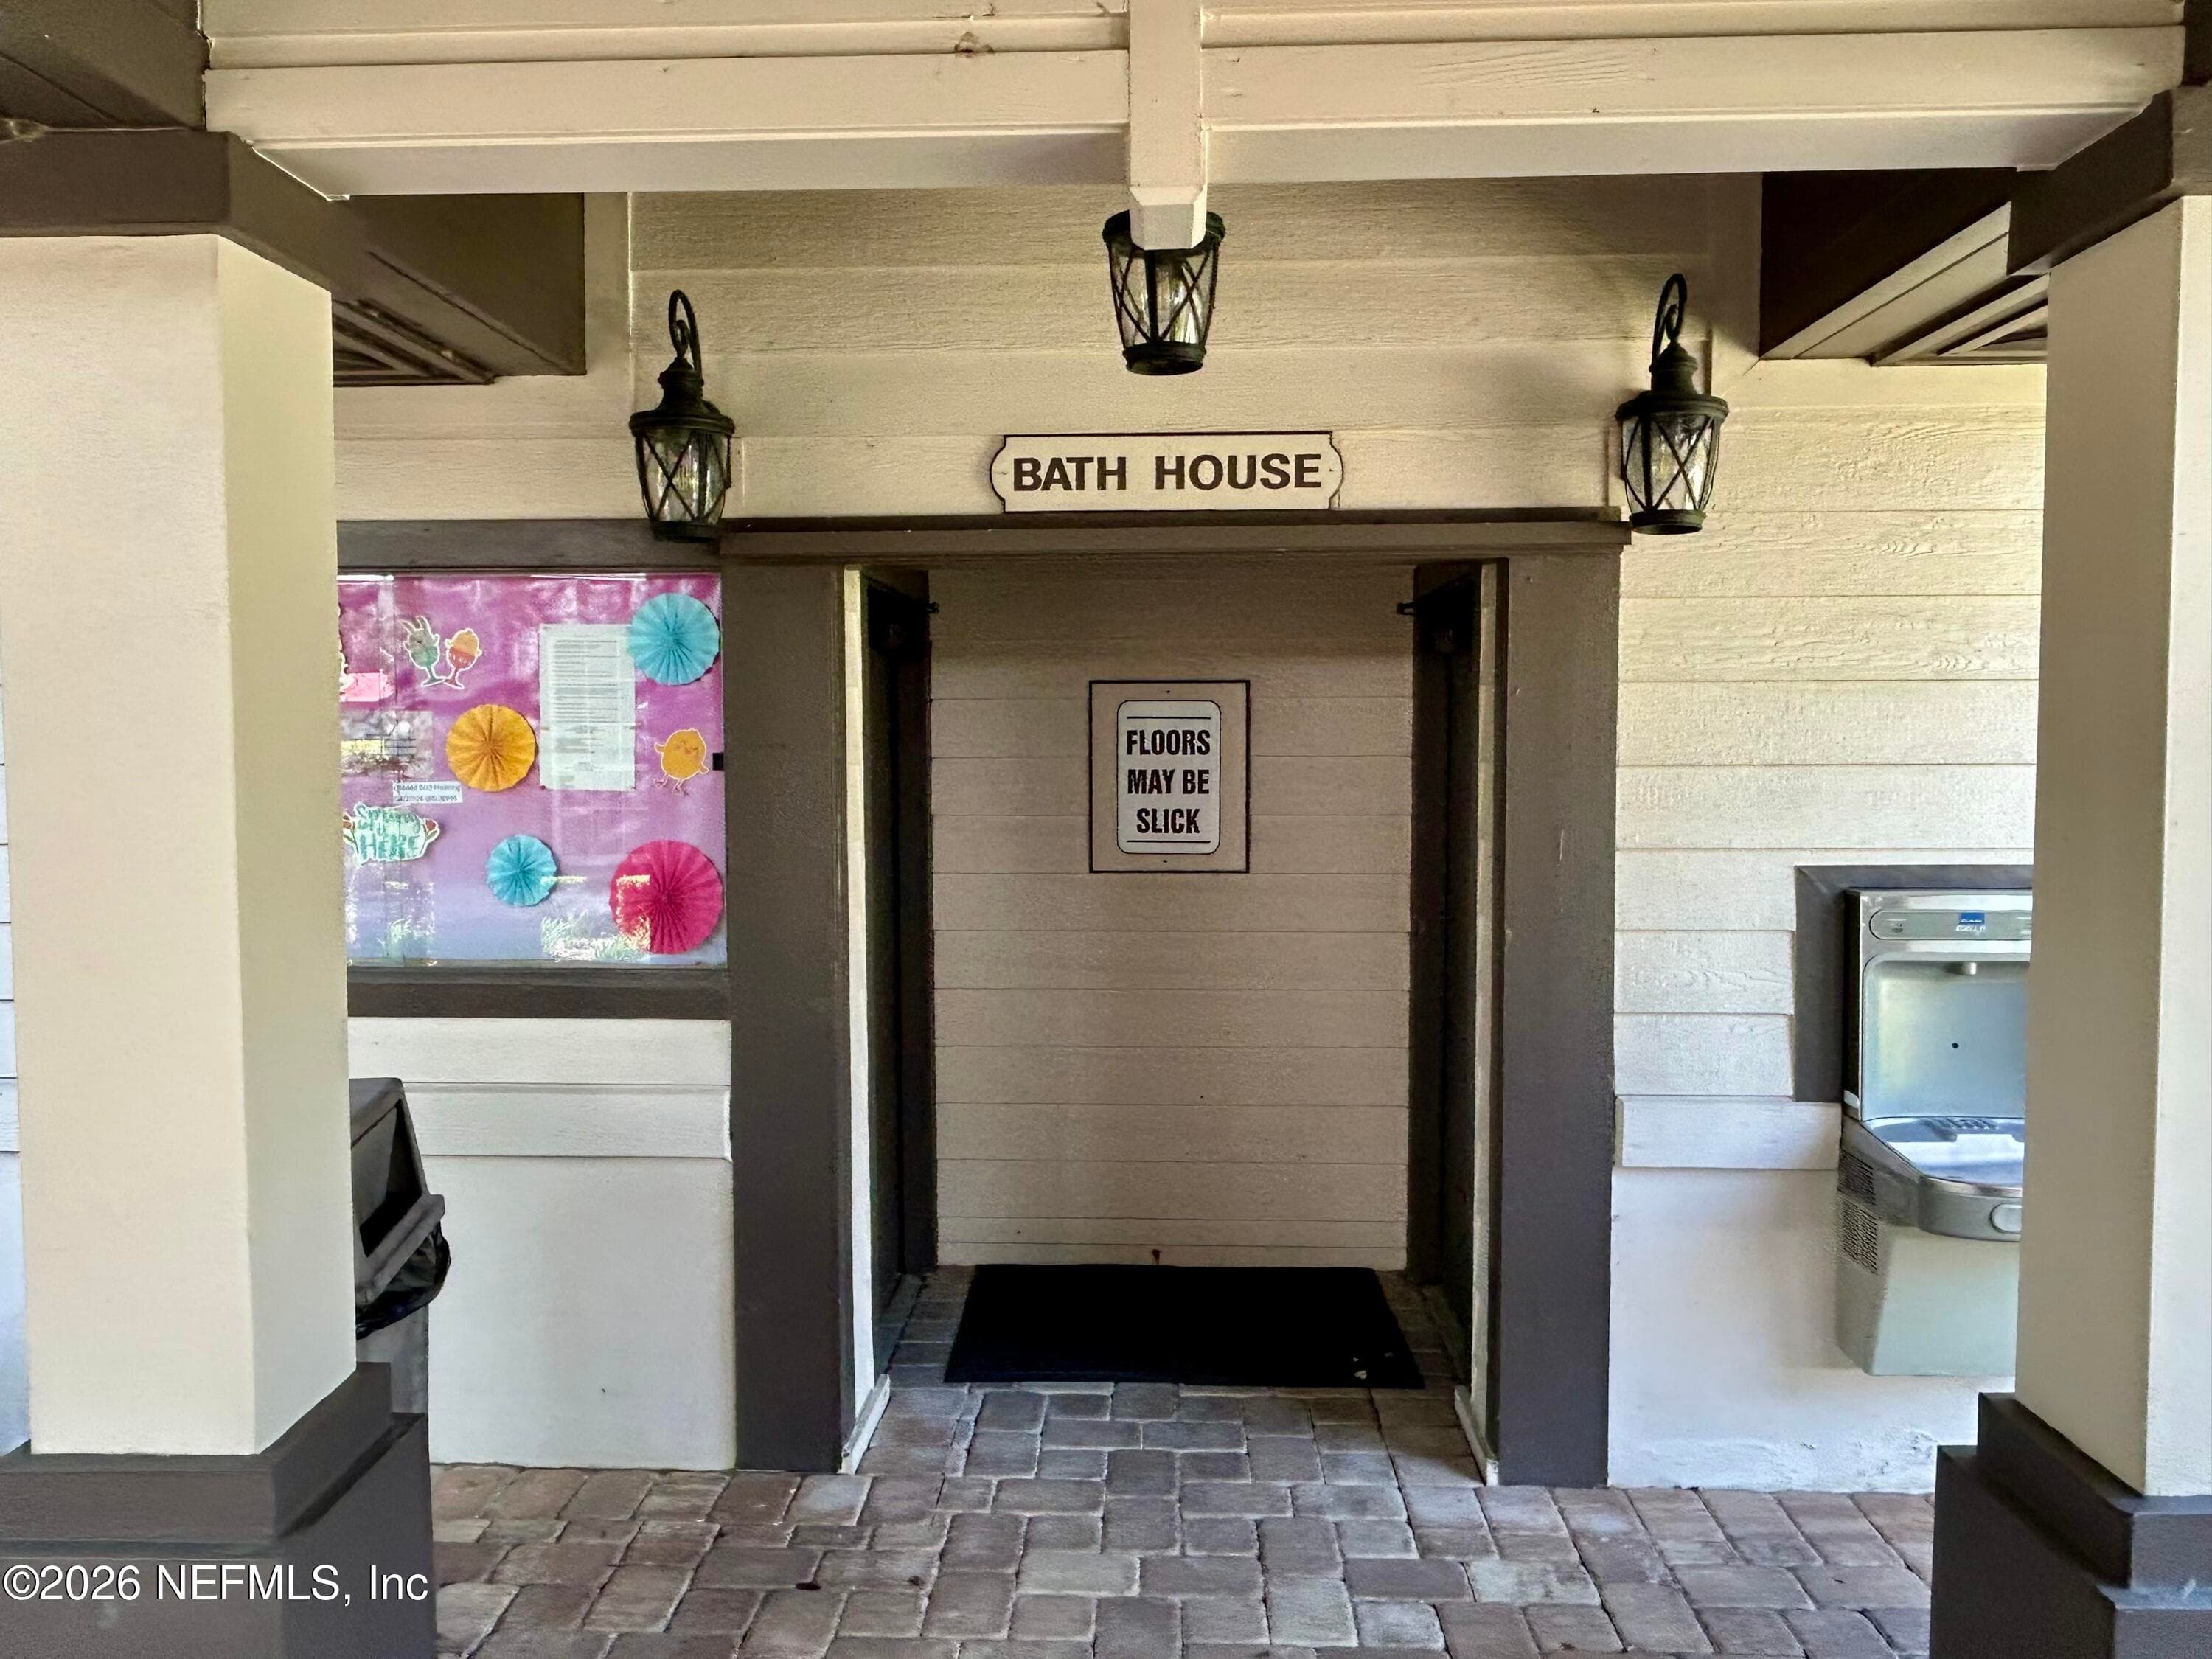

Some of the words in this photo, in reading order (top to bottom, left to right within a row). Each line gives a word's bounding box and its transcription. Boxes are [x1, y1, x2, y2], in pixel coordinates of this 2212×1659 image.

[1013, 456, 1127, 491] BATH
[1155, 453, 1321, 490] HOUSE
[1127, 729, 1211, 756] FLOORS
[1127, 769, 1175, 794] MAY
[1182, 769, 1210, 794] BE
[1136, 808, 1200, 834] SLICK
